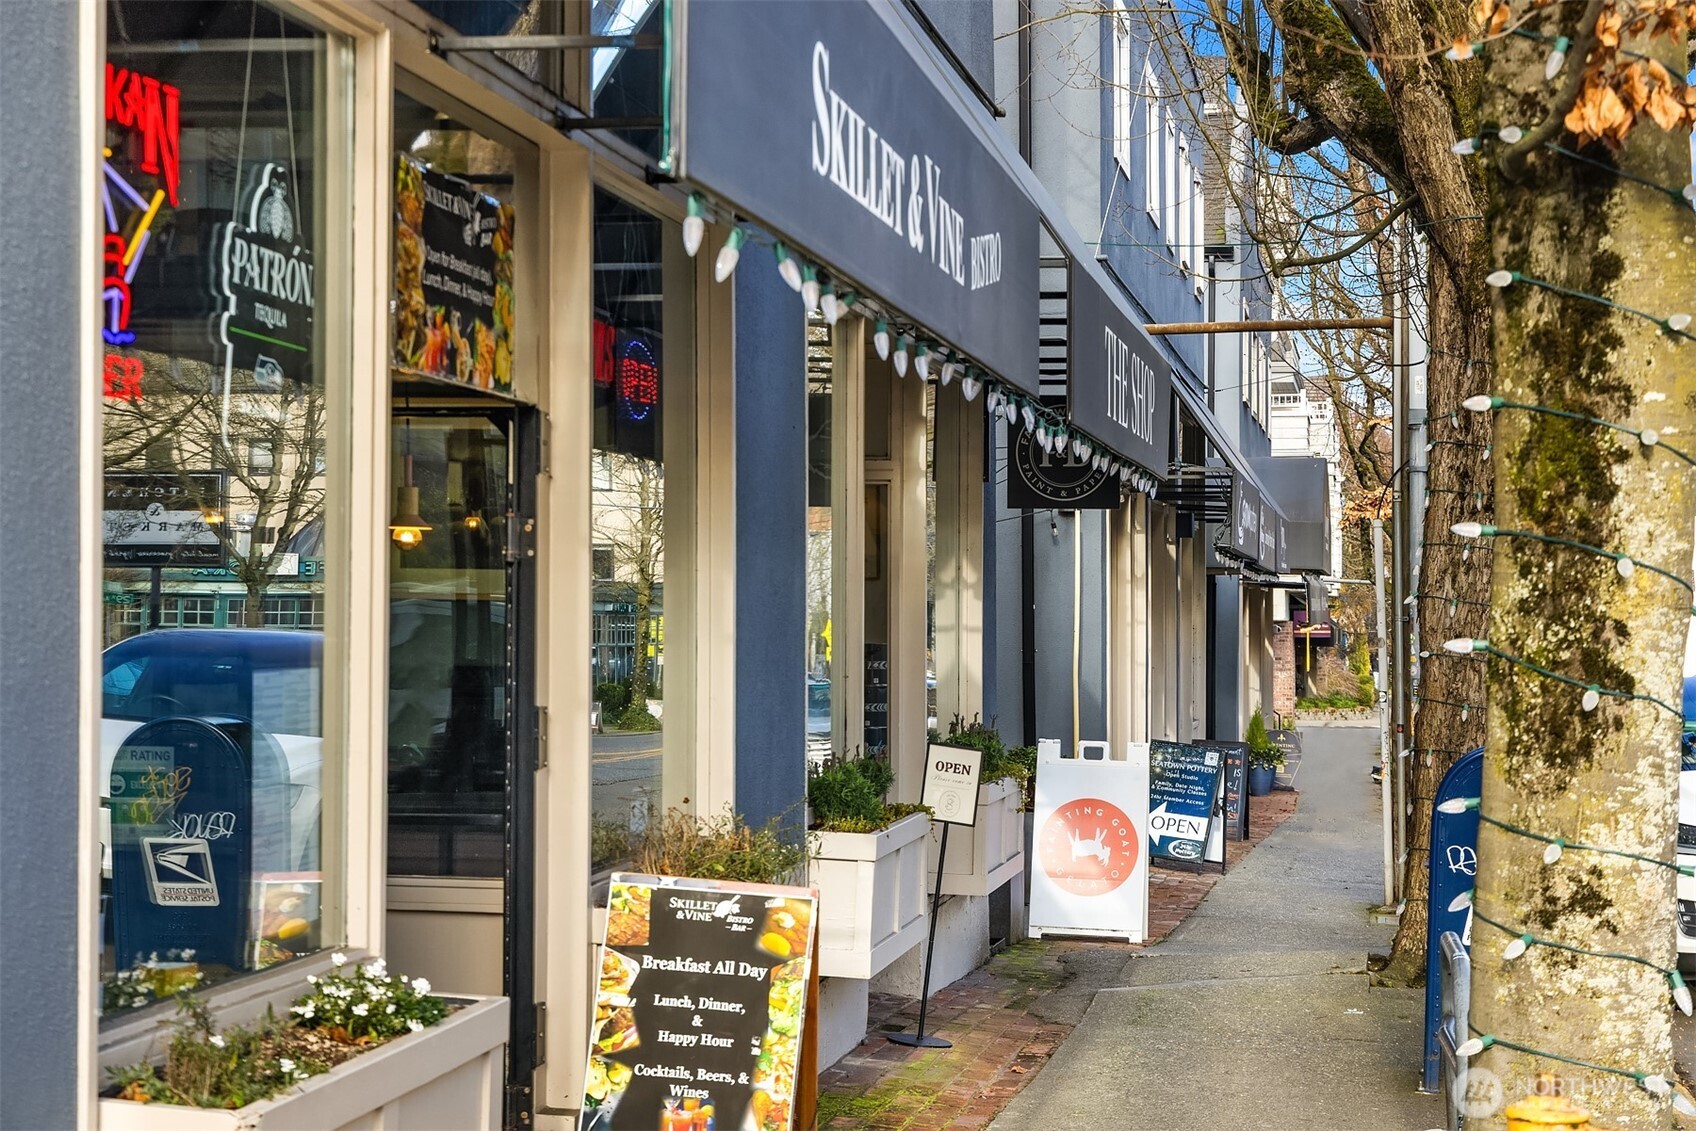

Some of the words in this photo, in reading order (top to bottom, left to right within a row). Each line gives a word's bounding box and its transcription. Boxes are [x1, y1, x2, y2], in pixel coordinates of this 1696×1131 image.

[811, 41, 905, 236] SKILLET
[908, 154, 924, 253] &
[924, 154, 965, 286] VINE
[970, 232, 1001, 291] BISTRO
[231, 235, 314, 307] PATRÓN
[1104, 325, 1129, 430] THE
[1131, 352, 1156, 446] SHOP
[1022, 463, 1053, 494] PAINT
[130, 750, 171, 762] RATING
[935, 760, 972, 776] OPEN
[1151, 758, 1186, 772] SEATOWN
[1186, 763, 1218, 775] POTTERY
[1151, 815, 1200, 835] OPEN
[1111, 817, 1130, 857] GOAT
[669, 896, 718, 913] SKILLET
[726, 914, 754, 925] BISTRO
[641, 954, 711, 976] Breakfast
[712, 960, 735, 977] All
[738, 963, 768, 982] Day
[653, 994, 696, 1011] Lunch,
[698, 997, 747, 1015] Dinner,
[692, 1014, 704, 1028] &
[657, 1030, 698, 1048] Happy
[700, 1032, 735, 1048] Hour
[633, 1063, 694, 1081] Cocktails,
[696, 1068, 736, 1086] Beers,
[737, 1072, 750, 1085] &
[669, 1084, 710, 1099] Wines
